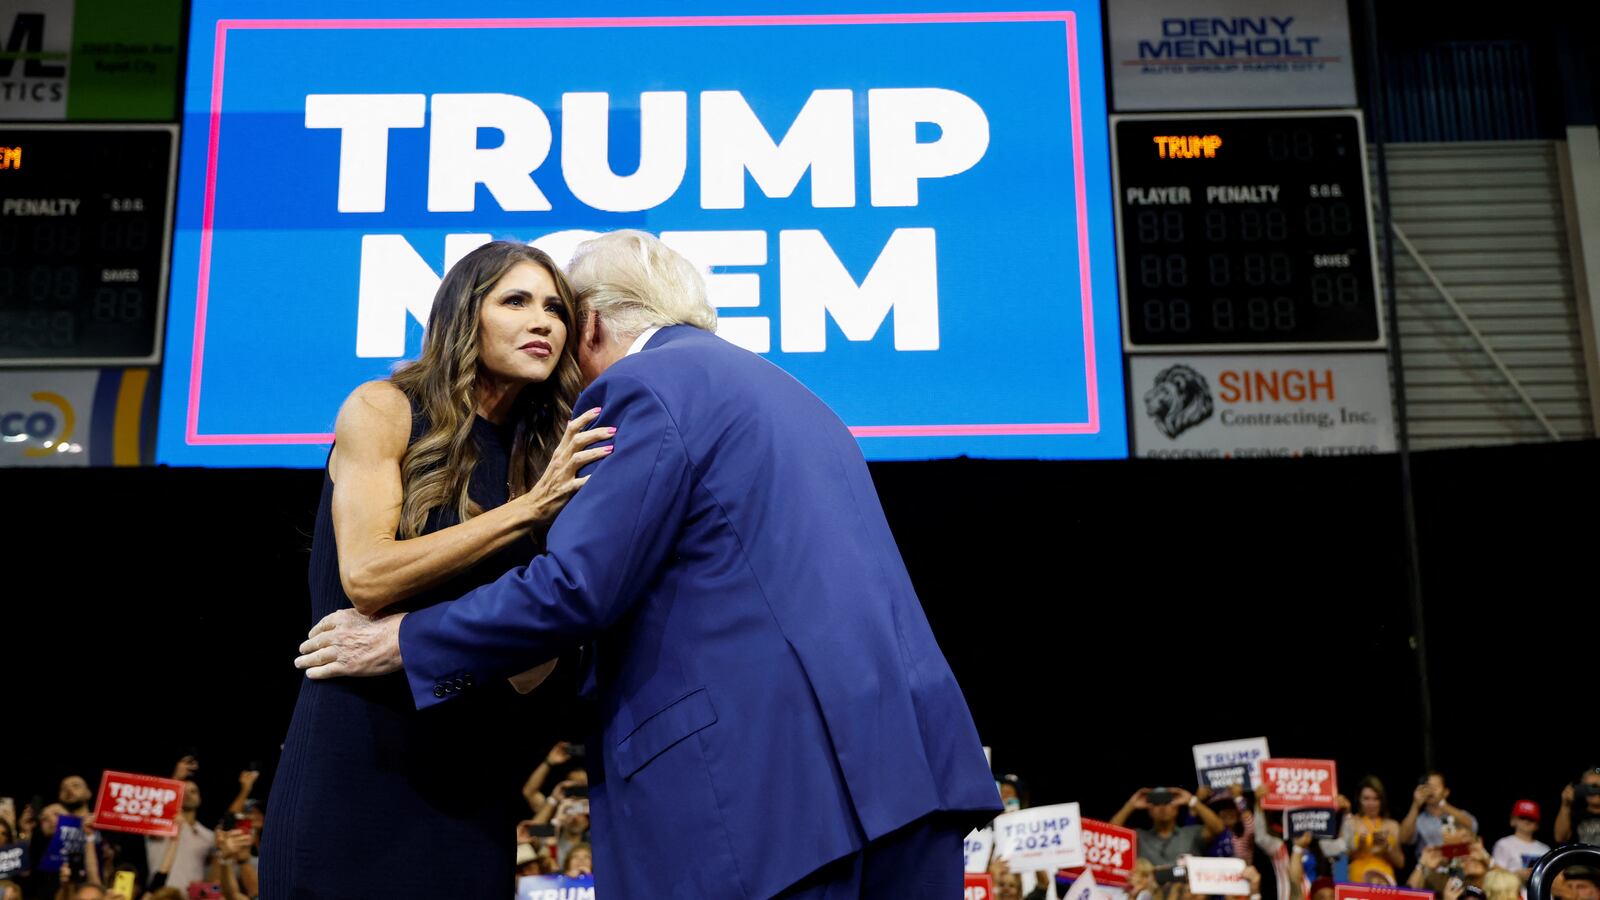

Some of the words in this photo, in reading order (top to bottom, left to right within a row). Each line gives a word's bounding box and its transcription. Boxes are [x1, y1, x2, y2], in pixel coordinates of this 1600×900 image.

[1162, 16, 1294, 37] DENNY
[1138, 36, 1320, 59] MENHOLT
[305, 87, 990, 213] TRUMP
[1153, 134, 1223, 159] TRUMP
[1127, 187, 1192, 205] PLAYER
[1206, 184, 1280, 205] PENALTY
[2, 197, 80, 216] PENALTY
[1313, 253, 1352, 268] SAVES
[100, 268, 140, 283] SAVES
[356, 227, 940, 357] NEM
[1219, 369, 1335, 403] SINGH
[1220, 409, 1335, 427] Contracting,
[1340, 407, 1377, 425] Inc.
[1204, 748, 1261, 764] TRUMP
[1265, 767, 1329, 783] TRUMP
[108, 781, 177, 804] TRUMP
[1275, 780, 1322, 796] 2024
[113, 796, 165, 818] 2024
[1004, 817, 1070, 837] TRUMP
[1013, 833, 1062, 851] 2024
